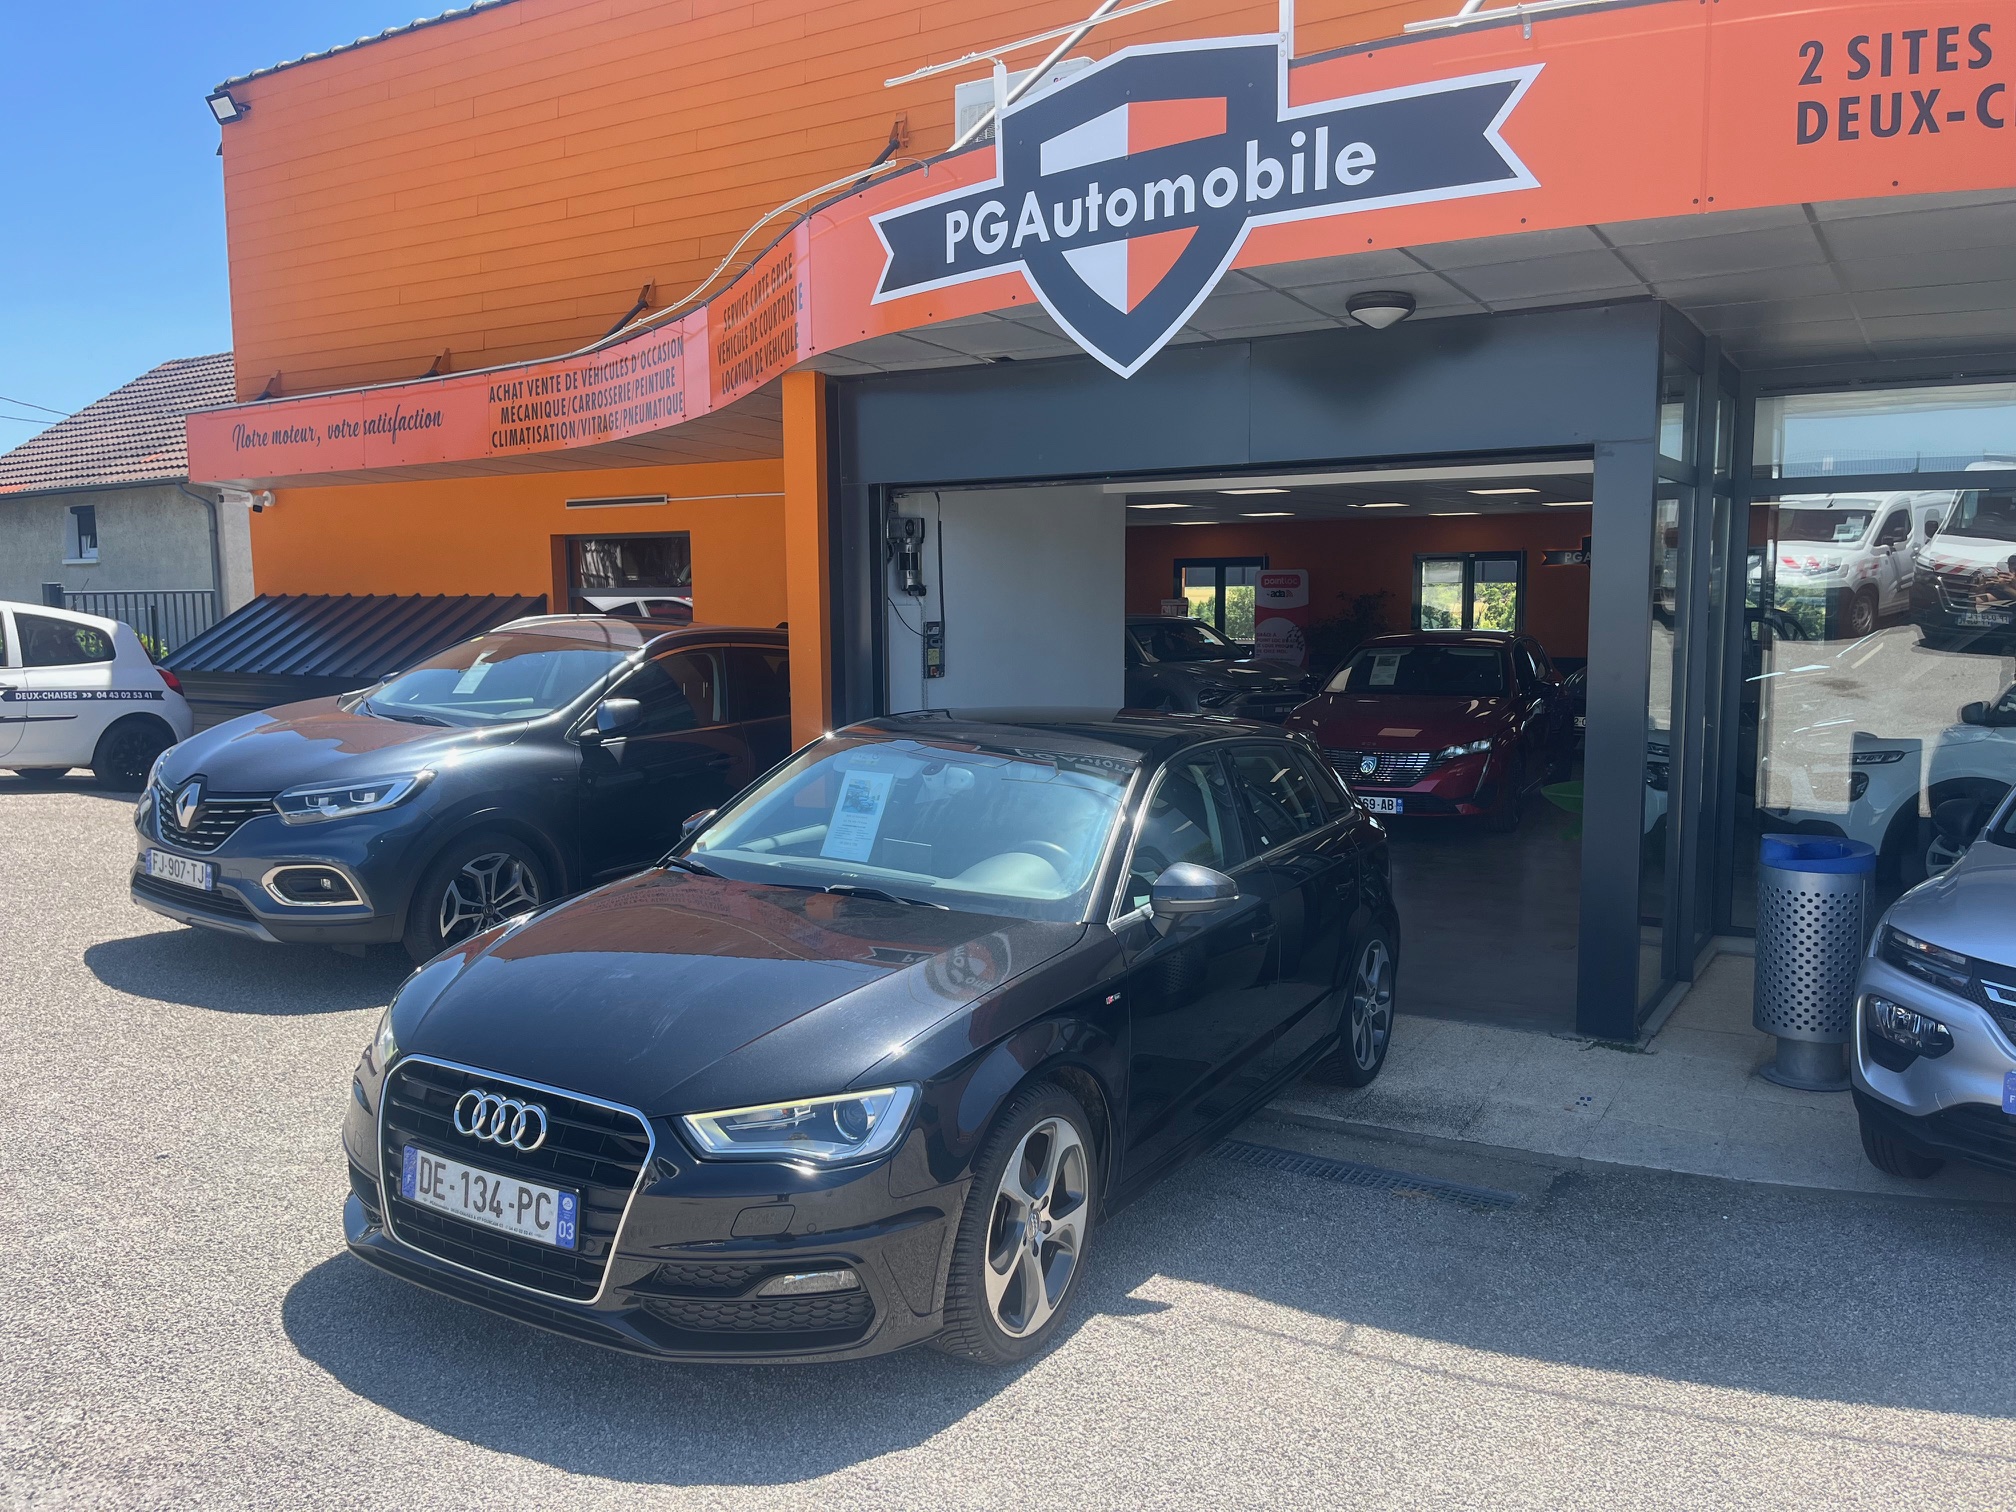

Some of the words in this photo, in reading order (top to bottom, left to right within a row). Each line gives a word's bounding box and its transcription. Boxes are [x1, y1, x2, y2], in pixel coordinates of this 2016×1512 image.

[1797, 40, 1824, 86] 2
[1847, 23, 1992, 81] SITES
[1796, 83, 2016, 145] DEUX-C
[945, 125, 1376, 265] PGAutomobile
[723, 290, 749, 332] SERVICE
[750, 271, 770, 312] CARTE
[771, 252, 793, 294] GRISE
[717, 323, 749, 367] VÉHICULE
[750, 317, 758, 346] DE
[759, 281, 803, 339] COURTOISIE
[489, 381, 524, 403] ACHAT
[526, 372, 562, 397] VENTE
[565, 371, 578, 391] DE
[581, 357, 629, 388] VÉHICULES
[631, 335, 684, 376] D'OCCASION
[722, 353, 754, 395] LOCATION
[755, 350, 763, 376] DE
[764, 322, 800, 369] VÉHICULE
[232, 423, 269, 451] Notre
[271, 428, 321, 447] moteur,
[327, 420, 361, 440] votre
[363, 403, 444, 444] satisfaction
[491, 391, 684, 448] CLIMATISATION/VITRAGE/PNEUMATIQUE
[15, 691, 78, 700] DEUX-CHAISES
[96, 691, 107, 699] 04
[109, 691, 120, 699] 43
[121, 691, 131, 699] 02
[133, 691, 143, 699] 53
[144, 691, 153, 699] 41
[152, 852, 204, 884] FJ-907-TJ
[2009, 1094, 2016, 1104] F
[418, 1155, 552, 1231] DE-134-PC
[558, 1220, 575, 1240] 03
